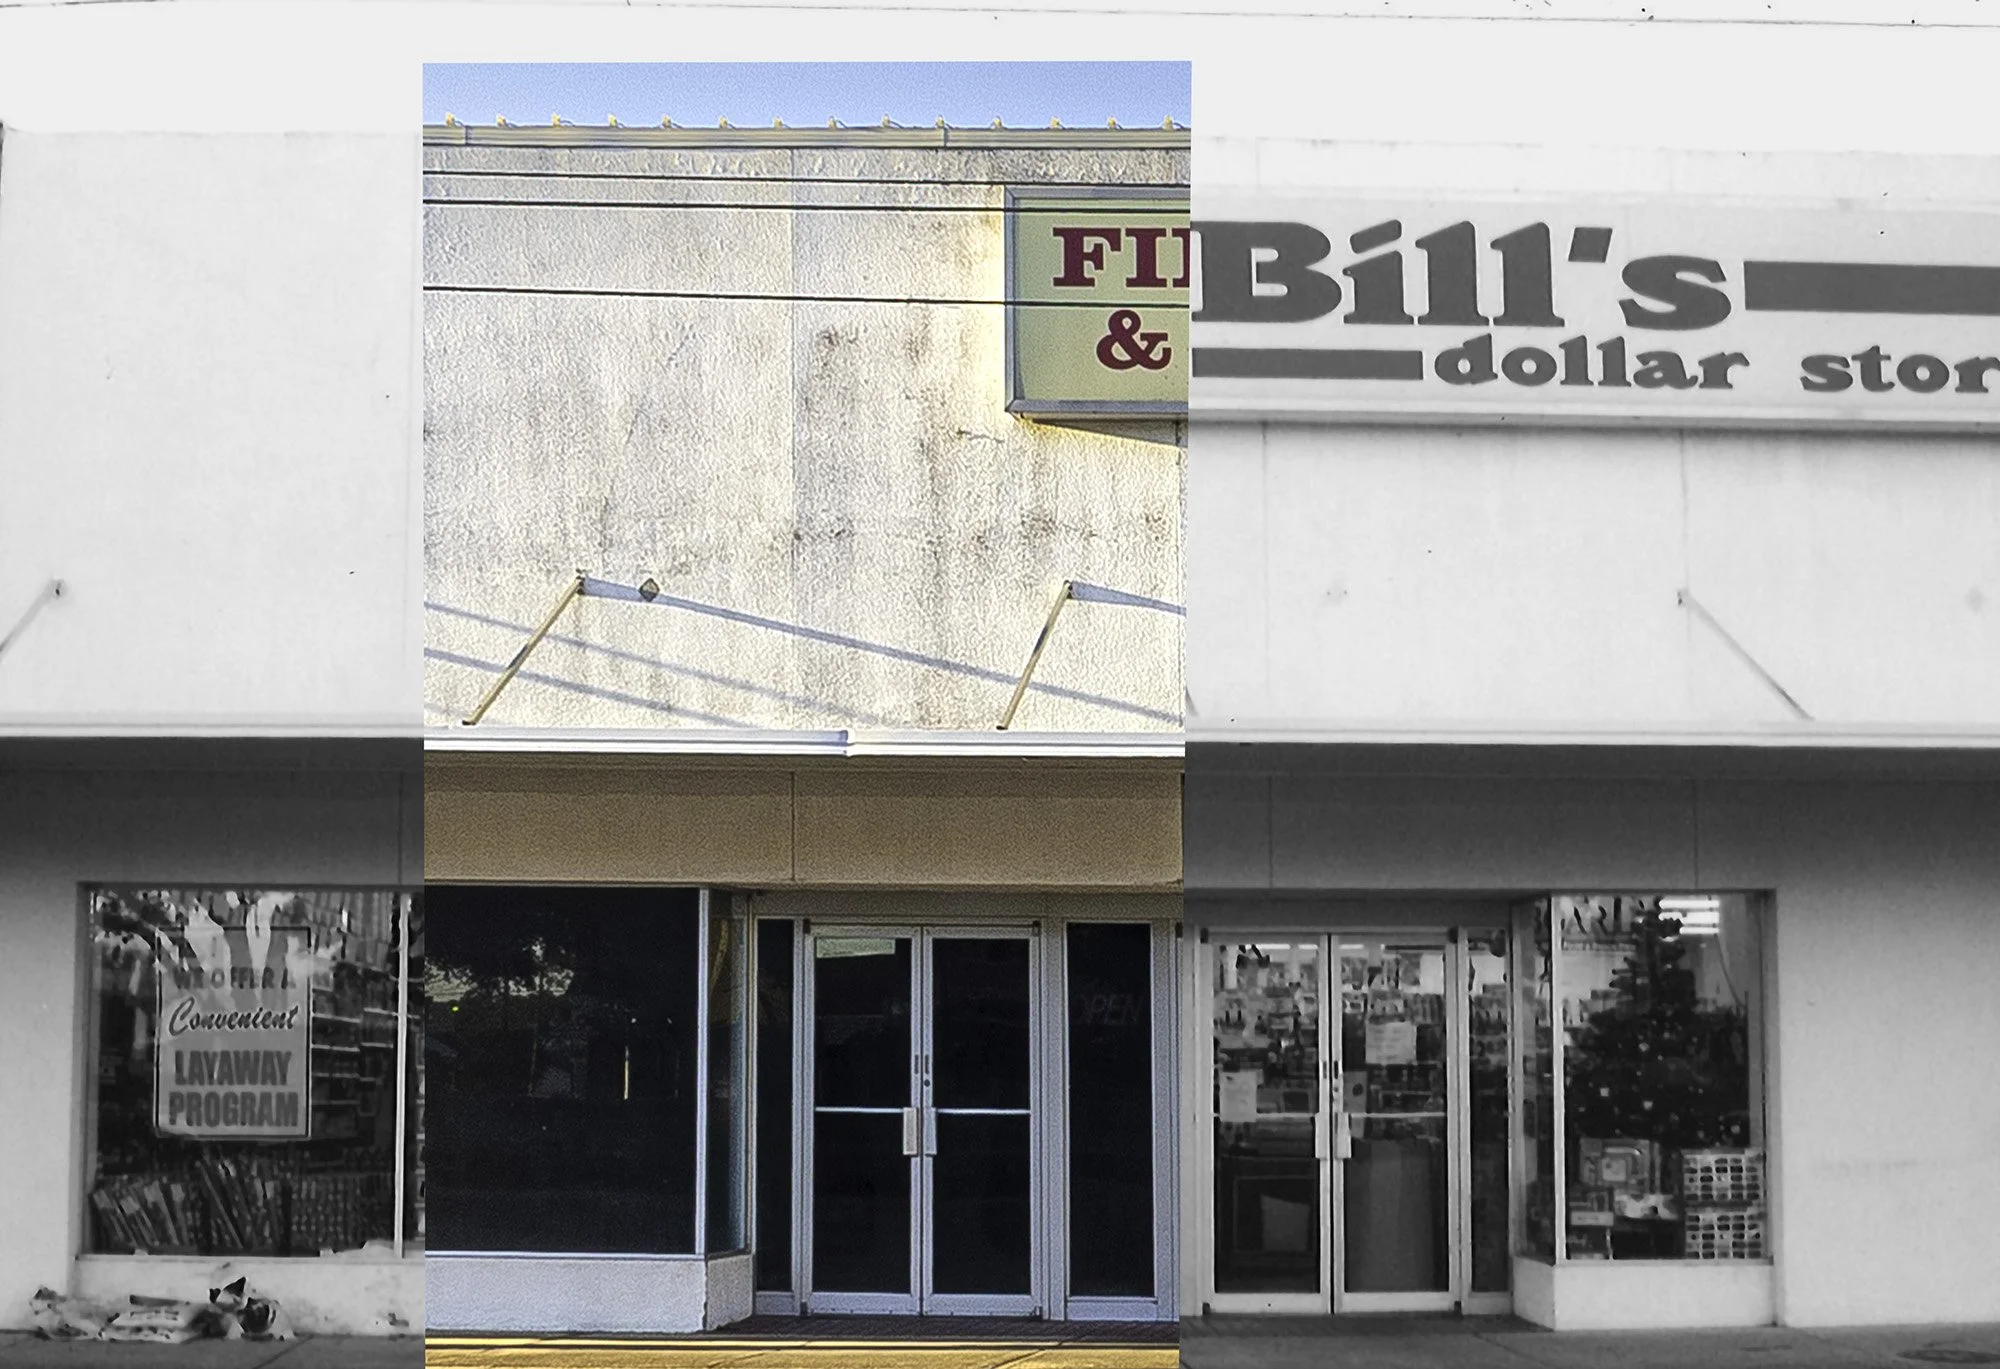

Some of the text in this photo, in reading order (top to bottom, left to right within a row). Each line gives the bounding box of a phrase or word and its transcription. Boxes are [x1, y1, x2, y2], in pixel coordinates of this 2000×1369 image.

[1191, 220, 1732, 331] Bill's
[1096, 309, 1172, 371] &
[1434, 333, 1749, 390] dollar
[168, 996, 299, 1037] Convenient
[174, 1050, 293, 1087] LAYAWAY
[168, 1091, 299, 1128] PROGRAM
